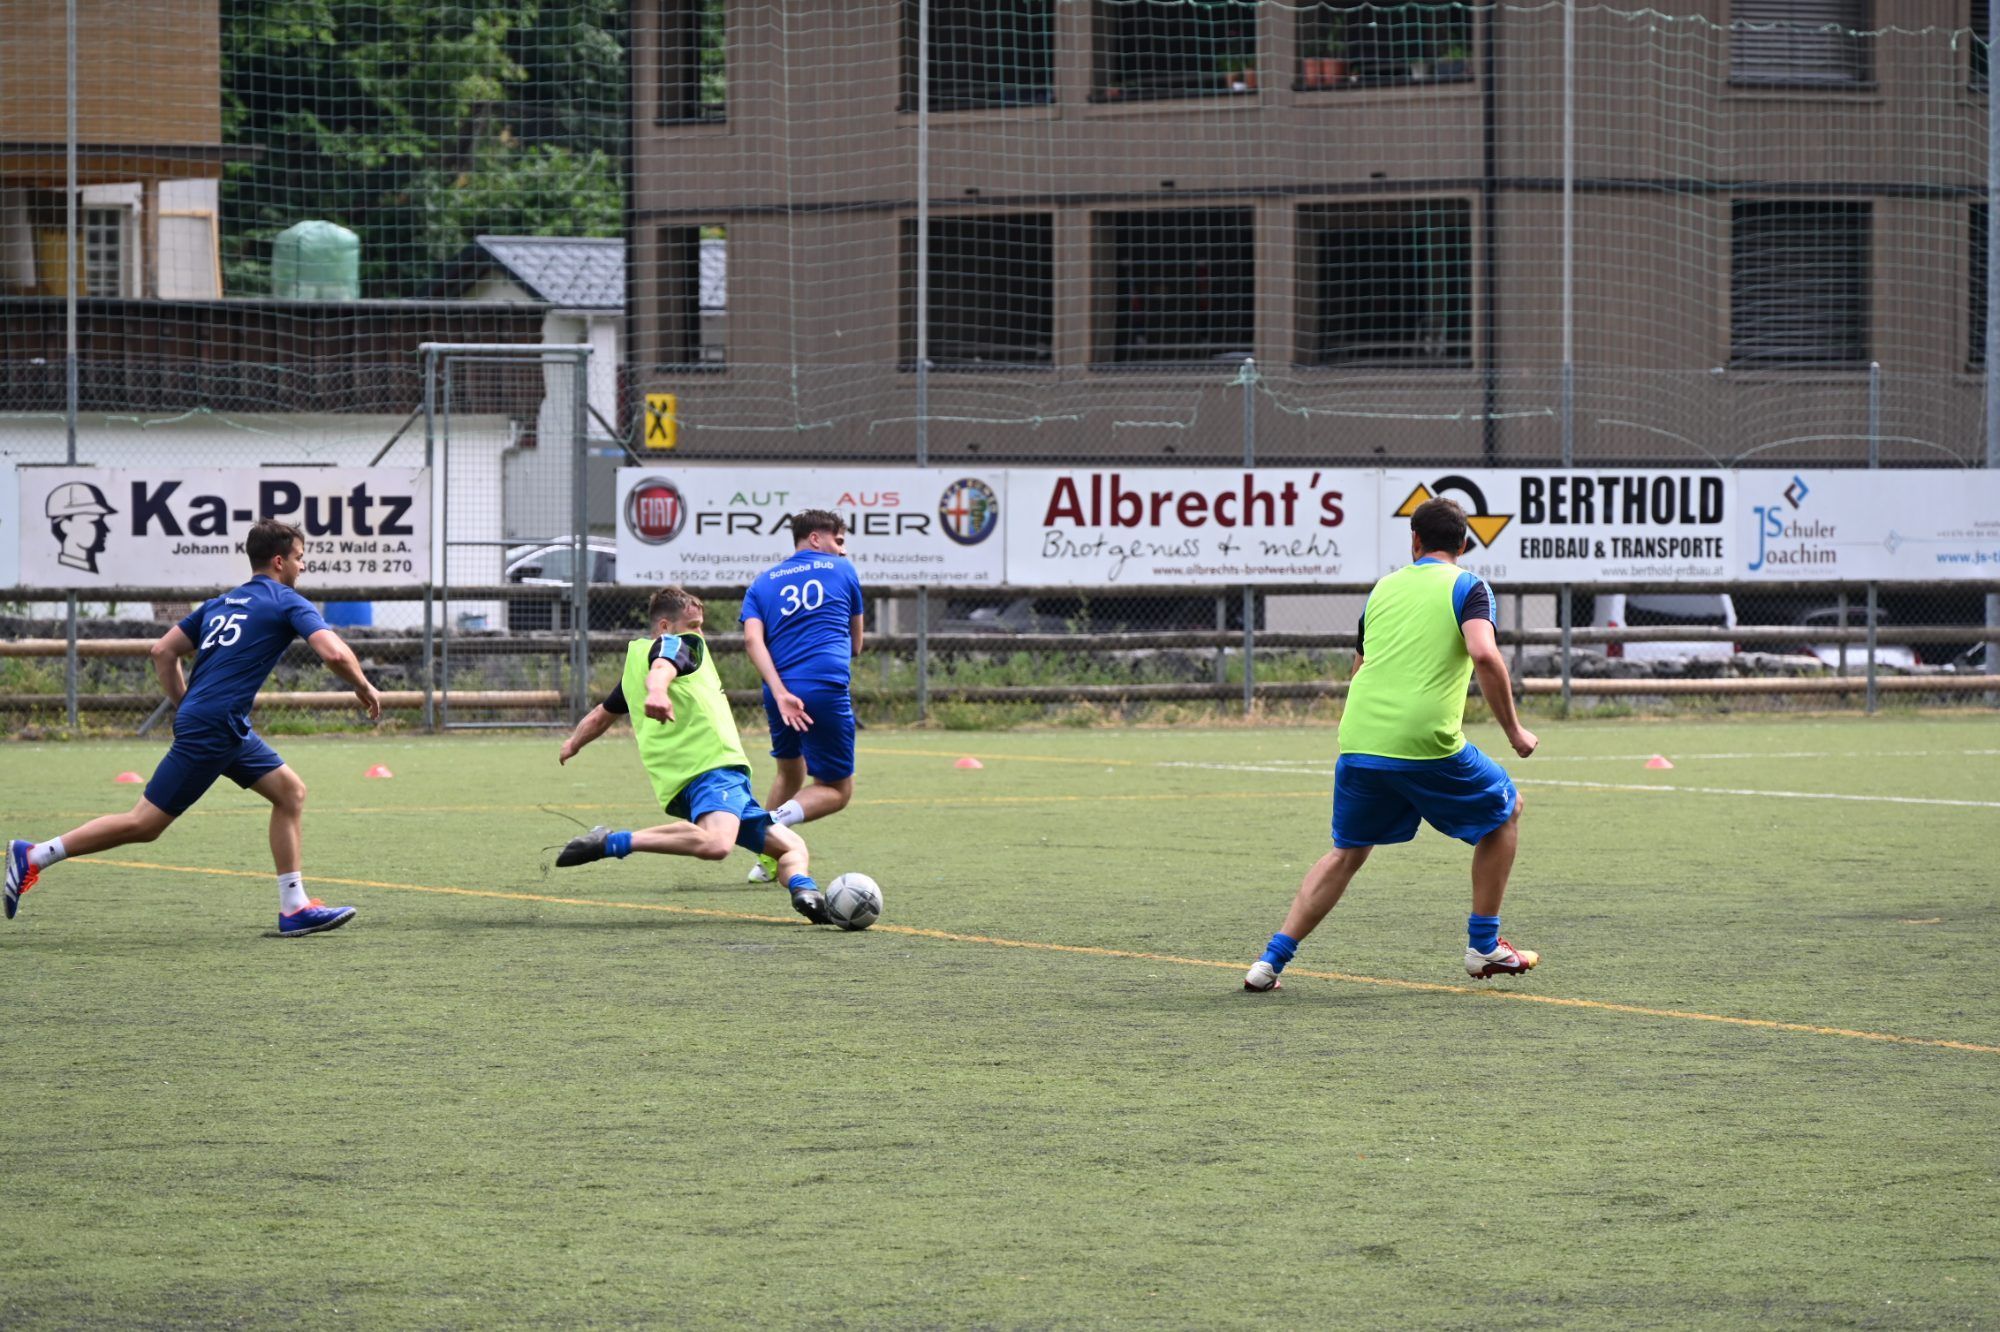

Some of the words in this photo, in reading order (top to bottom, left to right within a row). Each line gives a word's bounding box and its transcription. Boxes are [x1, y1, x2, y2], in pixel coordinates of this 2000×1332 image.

[132, 481, 413, 536] Ka-Putz
[640, 497, 675, 528] FIAT
[1043, 472, 1344, 527] Albrecht's
[1520, 476, 1724, 525] BERTHOLD
[696, 513, 931, 535] FRANER
[172, 542, 229, 555] Johann
[305, 541, 334, 554] 752
[340, 540, 380, 554] Wald
[1042, 530, 1200, 581] Brotgenuss
[1260, 533, 1342, 559] mehr
[1520, 537, 1589, 559] ERDBAU
[1594, 537, 1606, 559] &
[1611, 537, 1723, 559] TRANSPORTE
[358, 559, 376, 573] 78
[383, 559, 412, 573] 270
[715, 570, 758, 581] 6276
[769, 563, 811, 580] Schwoba
[813, 560, 834, 570] Bub
[1601, 563, 1724, 577] www.berthold-erdbau.at
[779, 579, 823, 616] 30
[200, 613, 248, 650] 25
